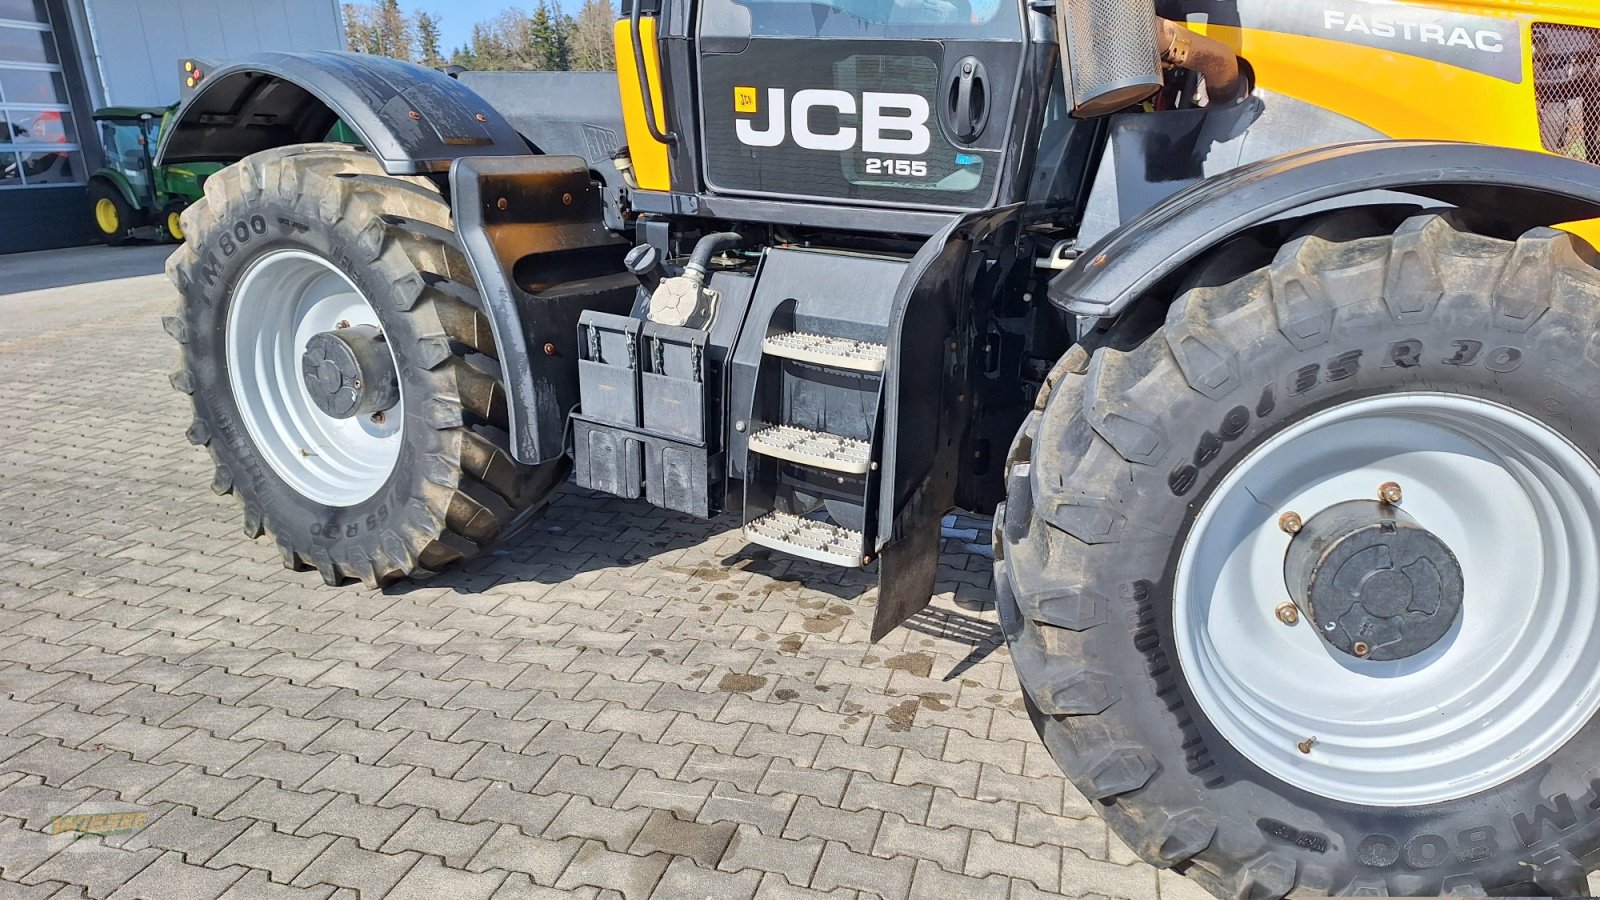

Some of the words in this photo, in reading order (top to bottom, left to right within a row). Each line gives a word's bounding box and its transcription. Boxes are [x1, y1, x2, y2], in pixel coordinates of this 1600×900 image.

[1323, 10, 1504, 53] FASTRAC
[735, 87, 931, 155] JCB
[865, 158, 928, 177] 2155
[216, 212, 269, 258] 800
[1380, 337, 1424, 370] R
[1441, 339, 1524, 375] 30
[345, 522, 360, 538] R
[1356, 824, 1500, 869] 800
